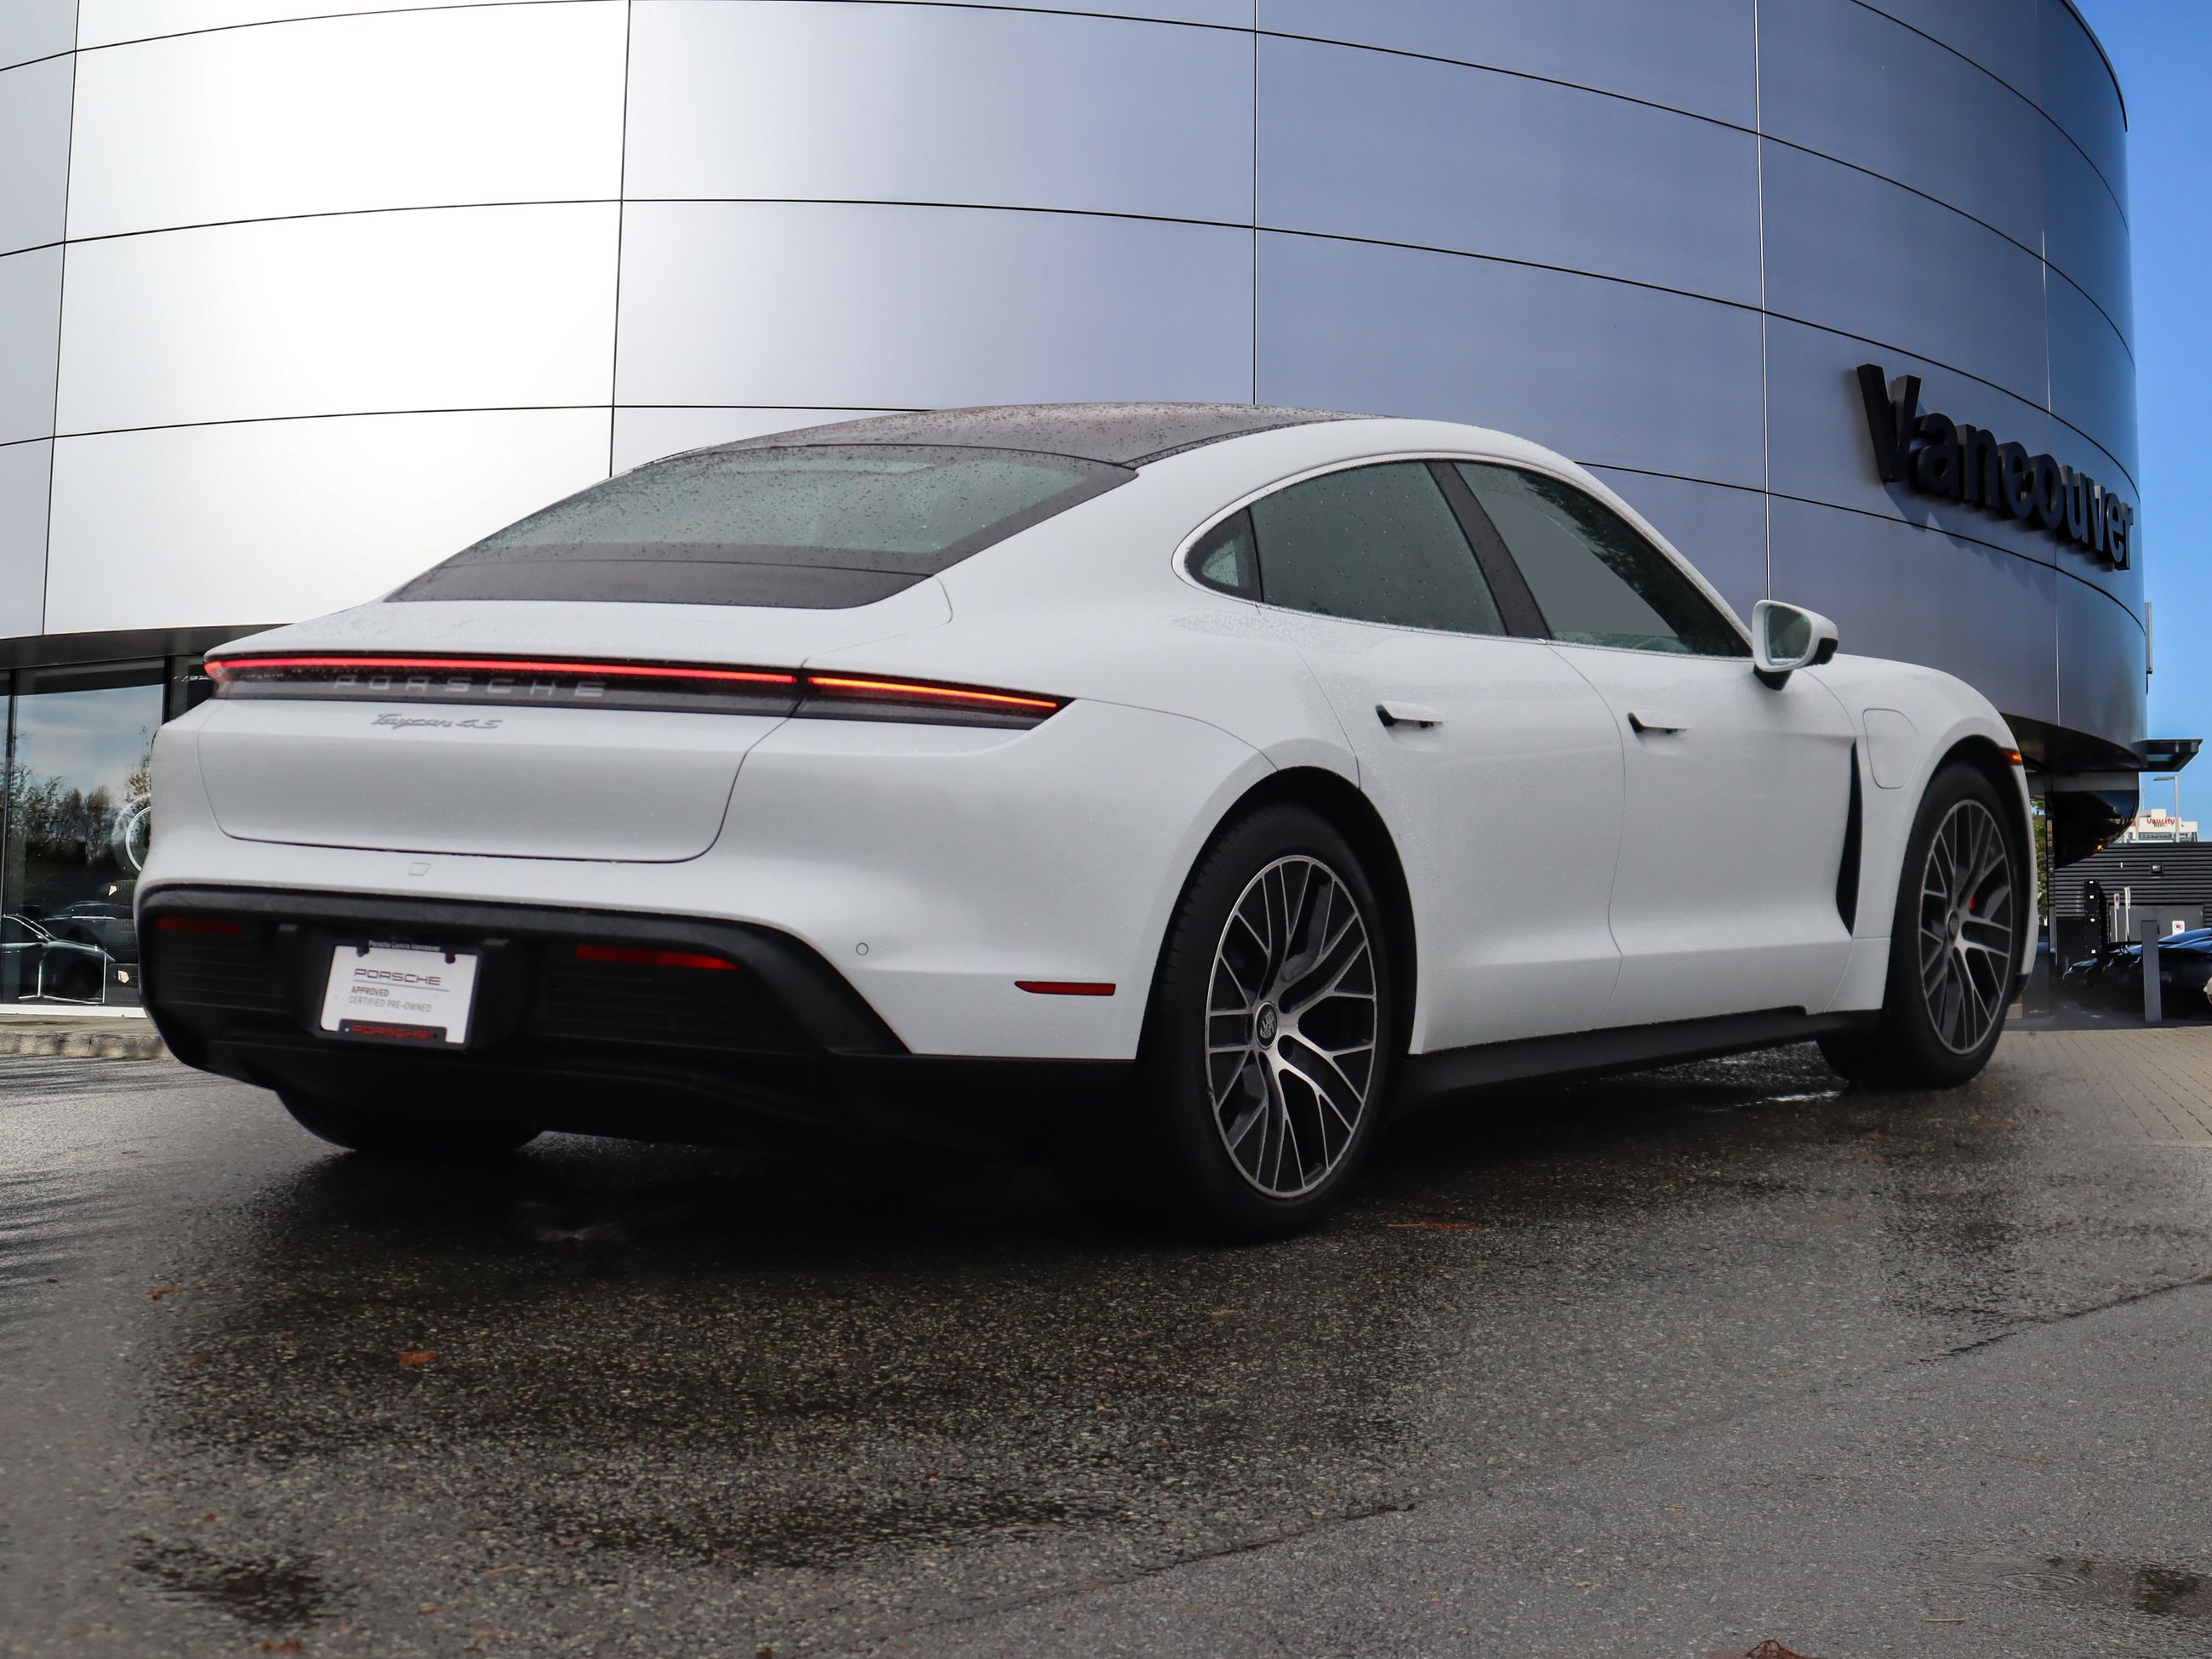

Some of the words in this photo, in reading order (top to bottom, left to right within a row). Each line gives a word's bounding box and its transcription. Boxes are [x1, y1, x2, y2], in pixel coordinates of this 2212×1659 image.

[1856, 363, 2134, 571] Vancouver
[334, 675, 606, 698] PORSCHE
[371, 713, 453, 729] Taycan
[456, 719, 503, 729] 4S
[368, 940, 391, 949] Porsche
[354, 968, 442, 986] PORSCHE
[351, 985, 389, 997] APPROVED
[349, 995, 385, 1007] CERTIFIED
[387, 1000, 432, 1012] PRE-OWNED
[351, 1025, 432, 1039] PORSCHE
